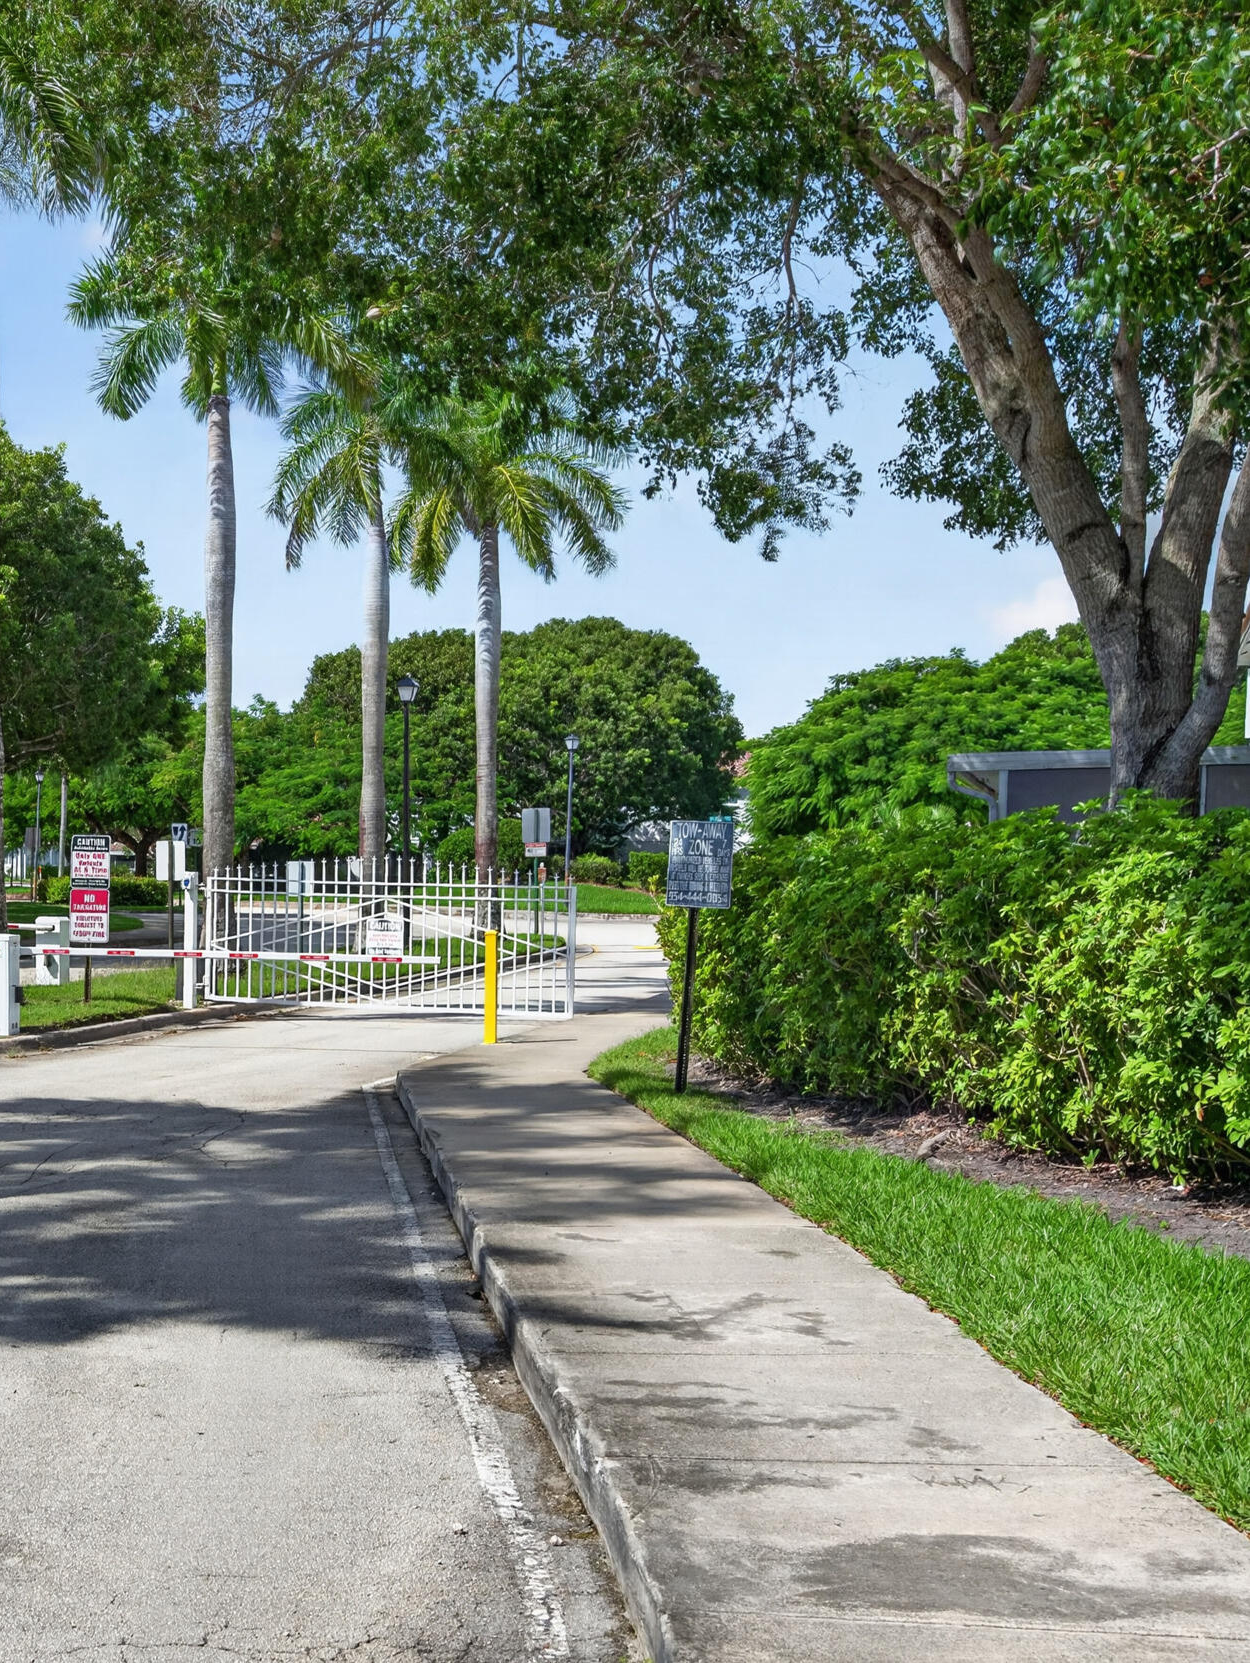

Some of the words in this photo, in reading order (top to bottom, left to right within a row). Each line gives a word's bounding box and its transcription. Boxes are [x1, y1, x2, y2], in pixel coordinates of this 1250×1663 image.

[677, 822, 728, 839] TOW-AWAY
[77, 838, 105, 846] CAUTION
[671, 847, 684, 856] HRS
[688, 839, 713, 856] ZONE
[84, 894, 95, 903] NO
